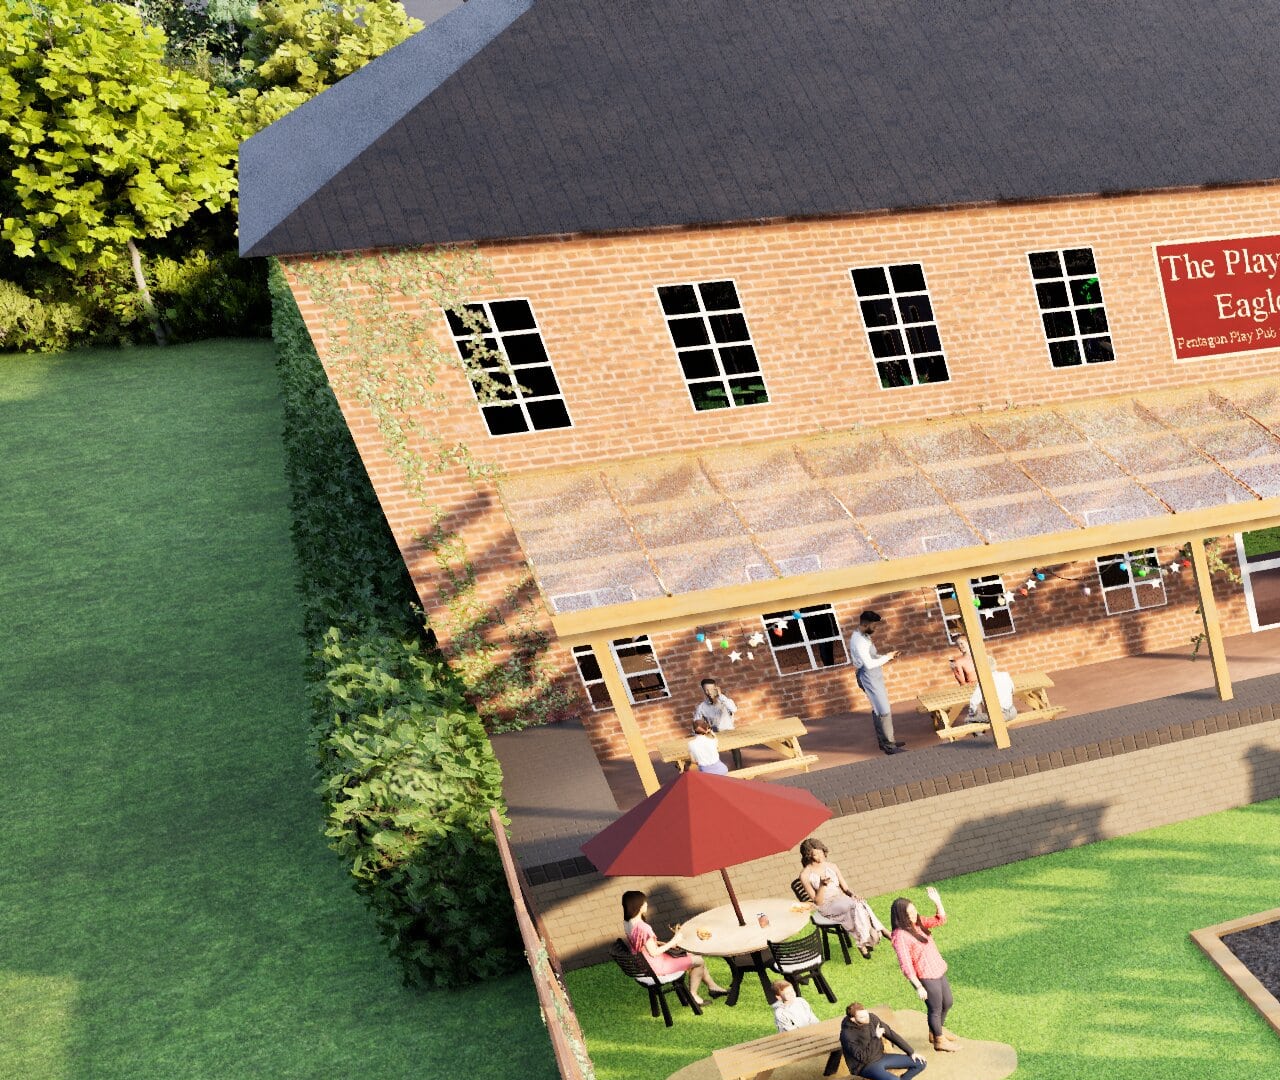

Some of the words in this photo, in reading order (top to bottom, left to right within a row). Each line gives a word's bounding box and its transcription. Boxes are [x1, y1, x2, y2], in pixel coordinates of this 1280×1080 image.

[1161, 252, 1215, 281] The
[1176, 336, 1229, 350] Pentagon
[1229, 330, 1253, 345] Play
[1255, 326, 1277, 341] Pub
